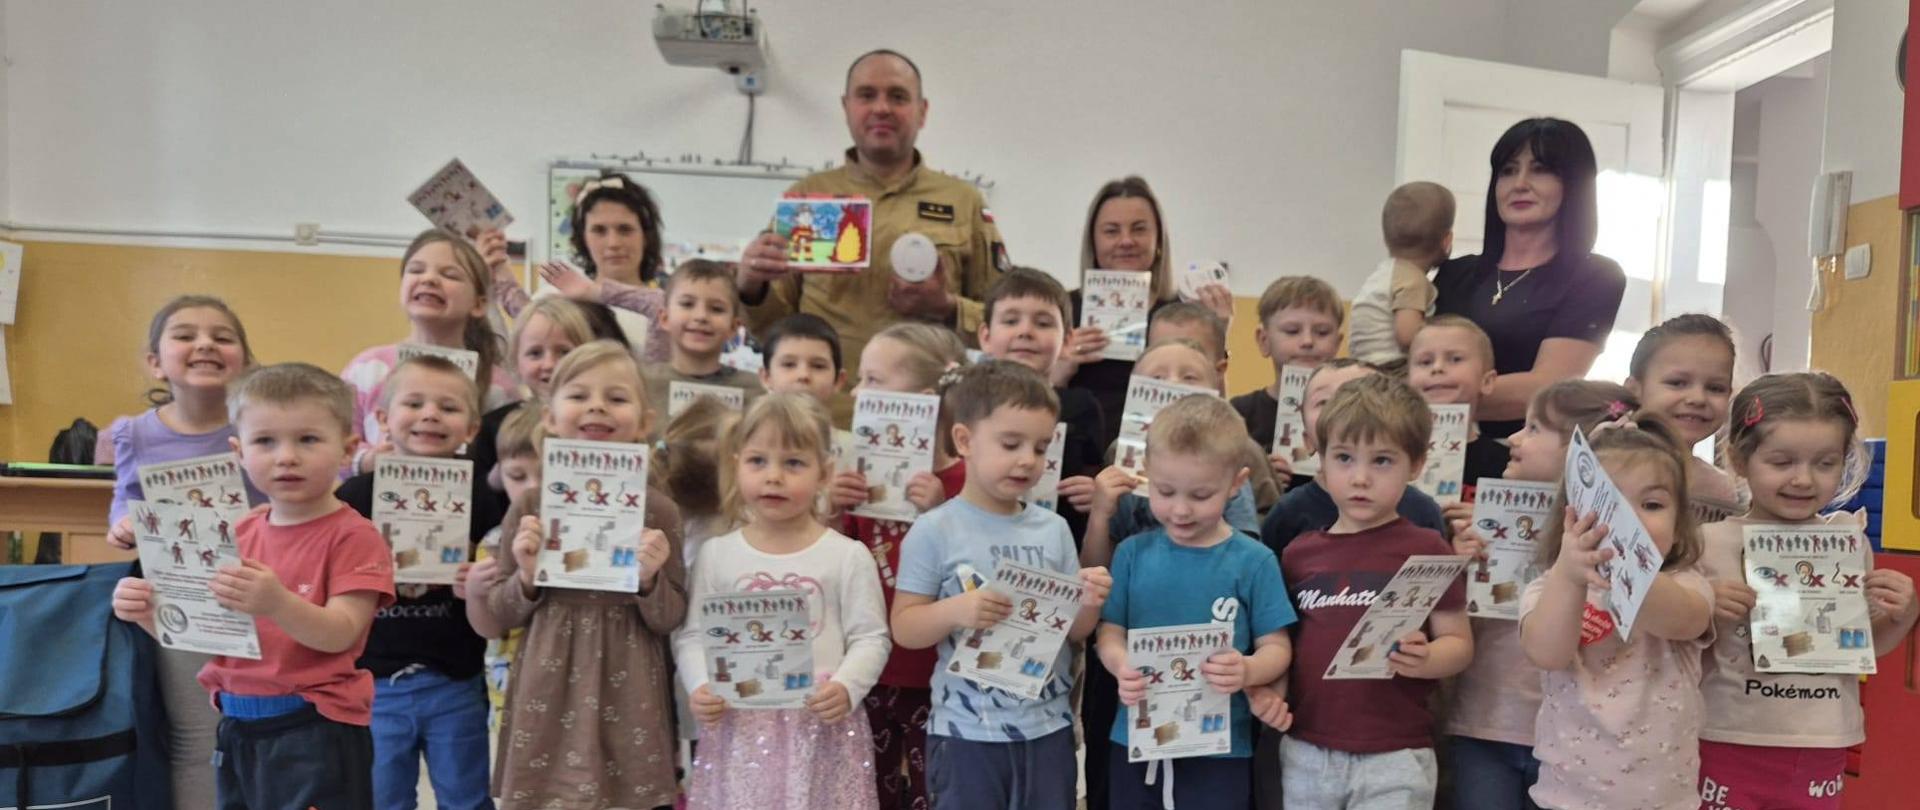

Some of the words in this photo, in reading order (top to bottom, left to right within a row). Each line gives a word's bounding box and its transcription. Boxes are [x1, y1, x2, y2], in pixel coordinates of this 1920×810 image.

[1297, 586, 1381, 610] Manhatt
[1745, 679, 1840, 699] Pokémon
[1702, 776, 1729, 805] BE
